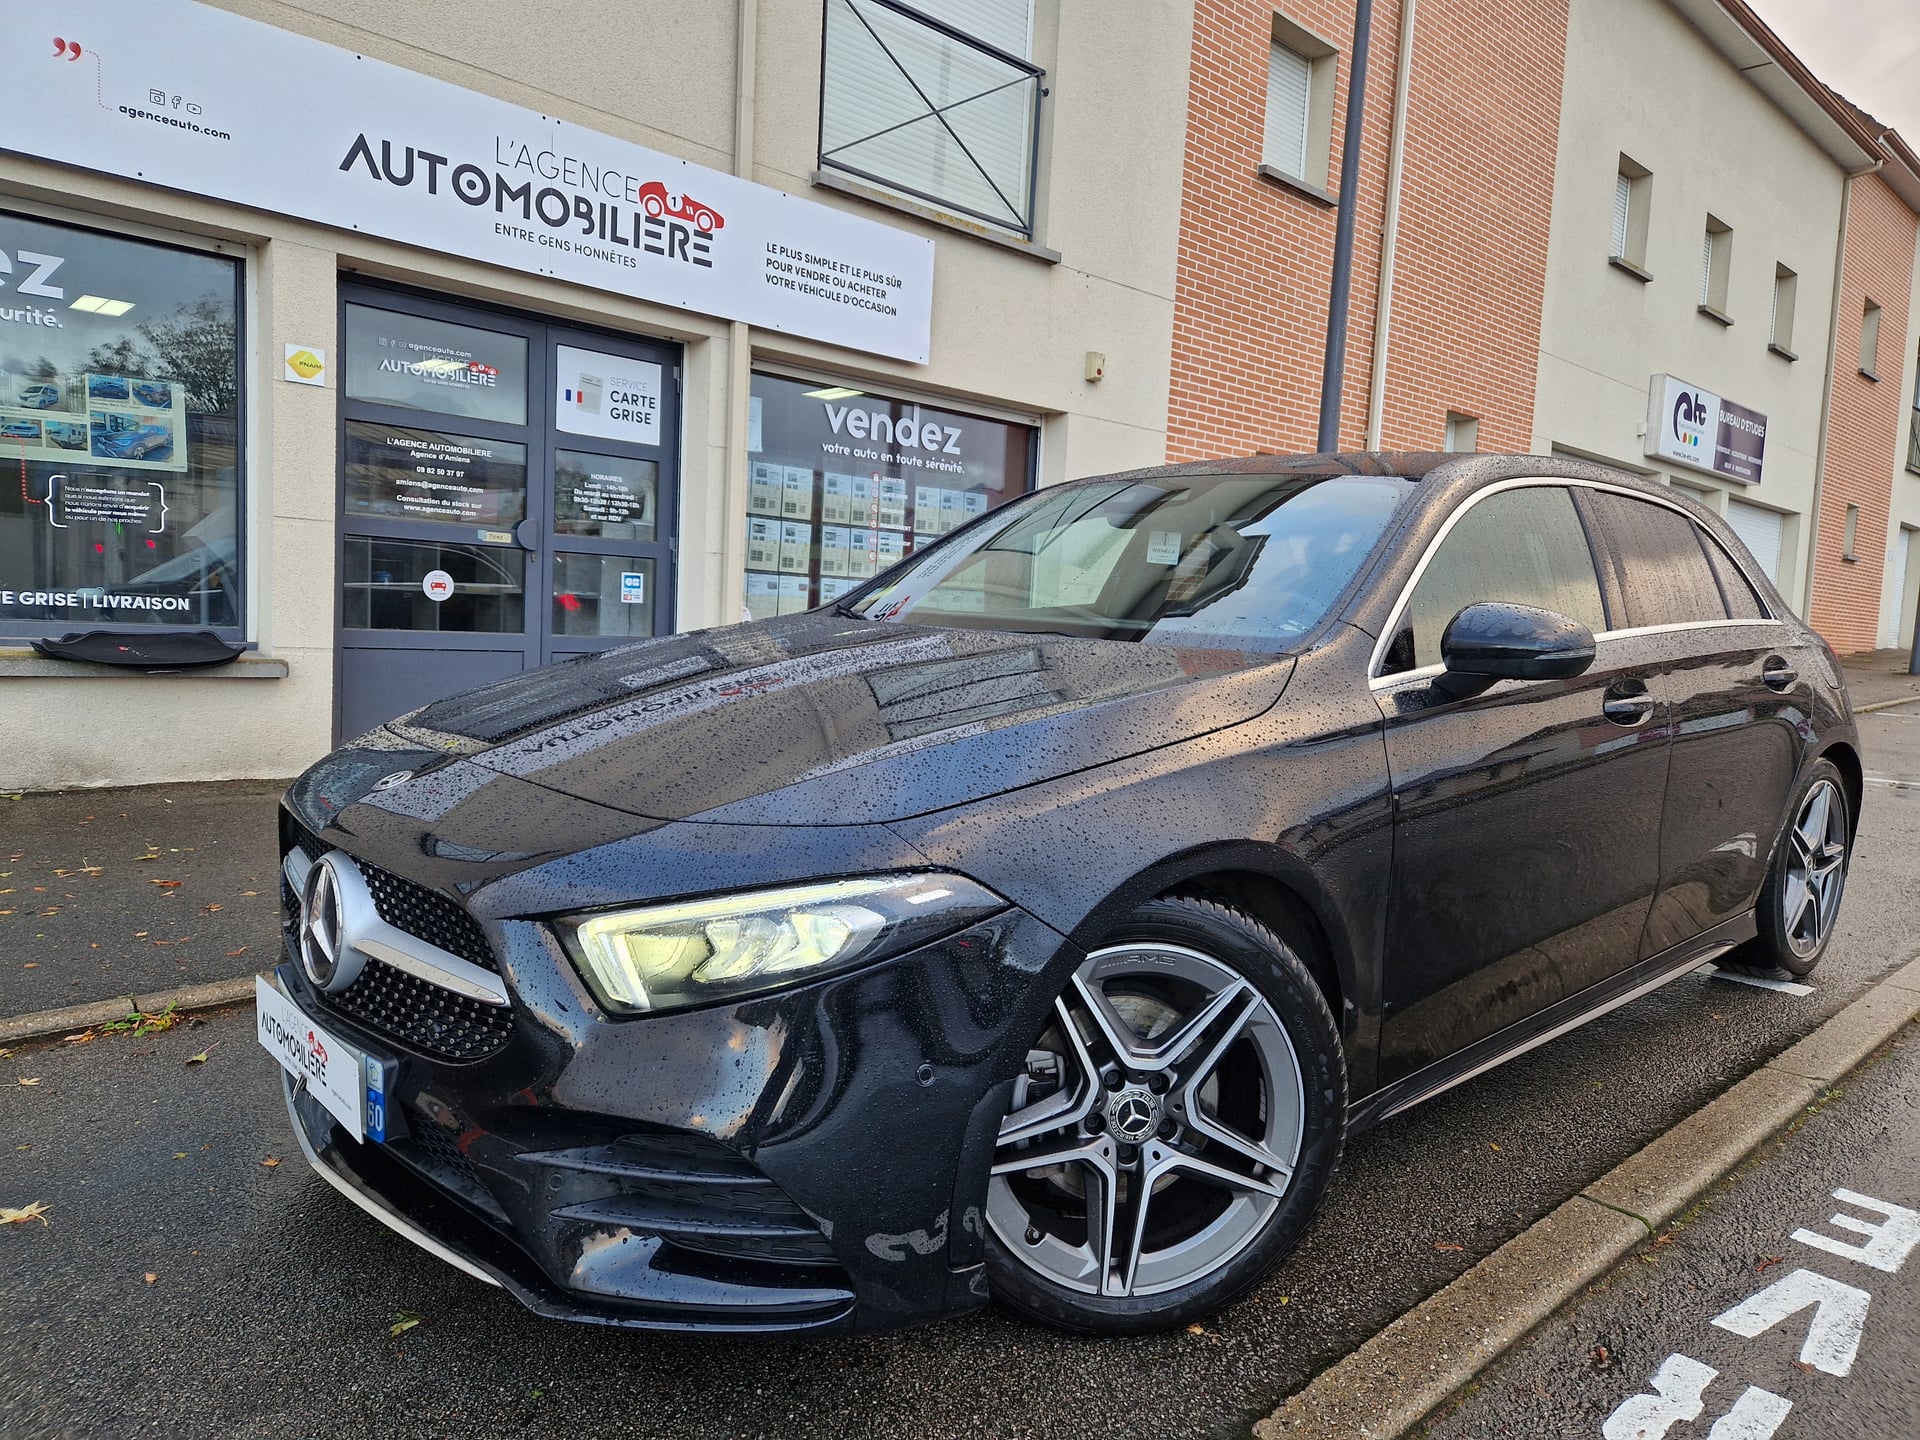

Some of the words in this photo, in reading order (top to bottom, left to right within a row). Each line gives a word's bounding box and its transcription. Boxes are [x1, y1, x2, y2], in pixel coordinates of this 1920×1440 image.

[119, 104, 231, 141] agenceauto.com
[496, 135, 639, 205] L'AGENCE
[339, 133, 714, 268] AUTOMOBILIERE
[495, 223, 535, 244] ENTRE
[538, 231, 570, 251] GENS
[574, 244, 637, 268] HONNÊTES
[766, 258, 793, 274] POUR
[794, 266, 831, 285] VENDRE
[832, 276, 846, 288] OU
[847, 281, 887, 300] ACHETER
[767, 242, 777, 254] LE
[780, 247, 803, 261] PLUS
[804, 253, 838, 272] SIMPLE
[840, 264, 851, 275] ET
[851, 268, 861, 278] LE
[863, 271, 884, 284] PLUS
[886, 276, 902, 289] SÛR
[766, 274, 796, 290] VOTRE
[798, 281, 842, 303] VÉHICULE
[844, 294, 897, 317] D'OCCASION
[408, 342, 472, 358] agenceauto.com
[300, 361, 322, 369] FNAIM
[379, 359, 496, 387] AUTOMOBILIERE
[610, 377, 648, 392] SERVICE
[610, 390, 656, 409] CARTE
[610, 407, 652, 425] GRISE
[824, 403, 962, 455] vendez
[1720, 410, 1740, 429] BUREAU
[1741, 418, 1765, 438] D'ETUDES
[387, 438, 428, 449] L'AGENCE
[429, 443, 493, 458] AUTOMOBILIERE
[410, 450, 437, 459] Agence
[438, 453, 471, 464] d'Amiens
[822, 442, 850, 455] votre
[854, 448, 878, 460] auto
[881, 452, 893, 464] en
[896, 452, 922, 468] toute
[925, 457, 965, 474] sérénité.
[396, 479, 484, 494] amiens@agenceauto.com
[396, 495, 440, 505] Consultation
[452, 500, 470, 508] stock
[404, 505, 477, 516] www.agenceauto.com
[18, 591, 79, 607] GRISE
[93, 594, 190, 611] LIVRAISON
[368, 1102, 383, 1131] 60
